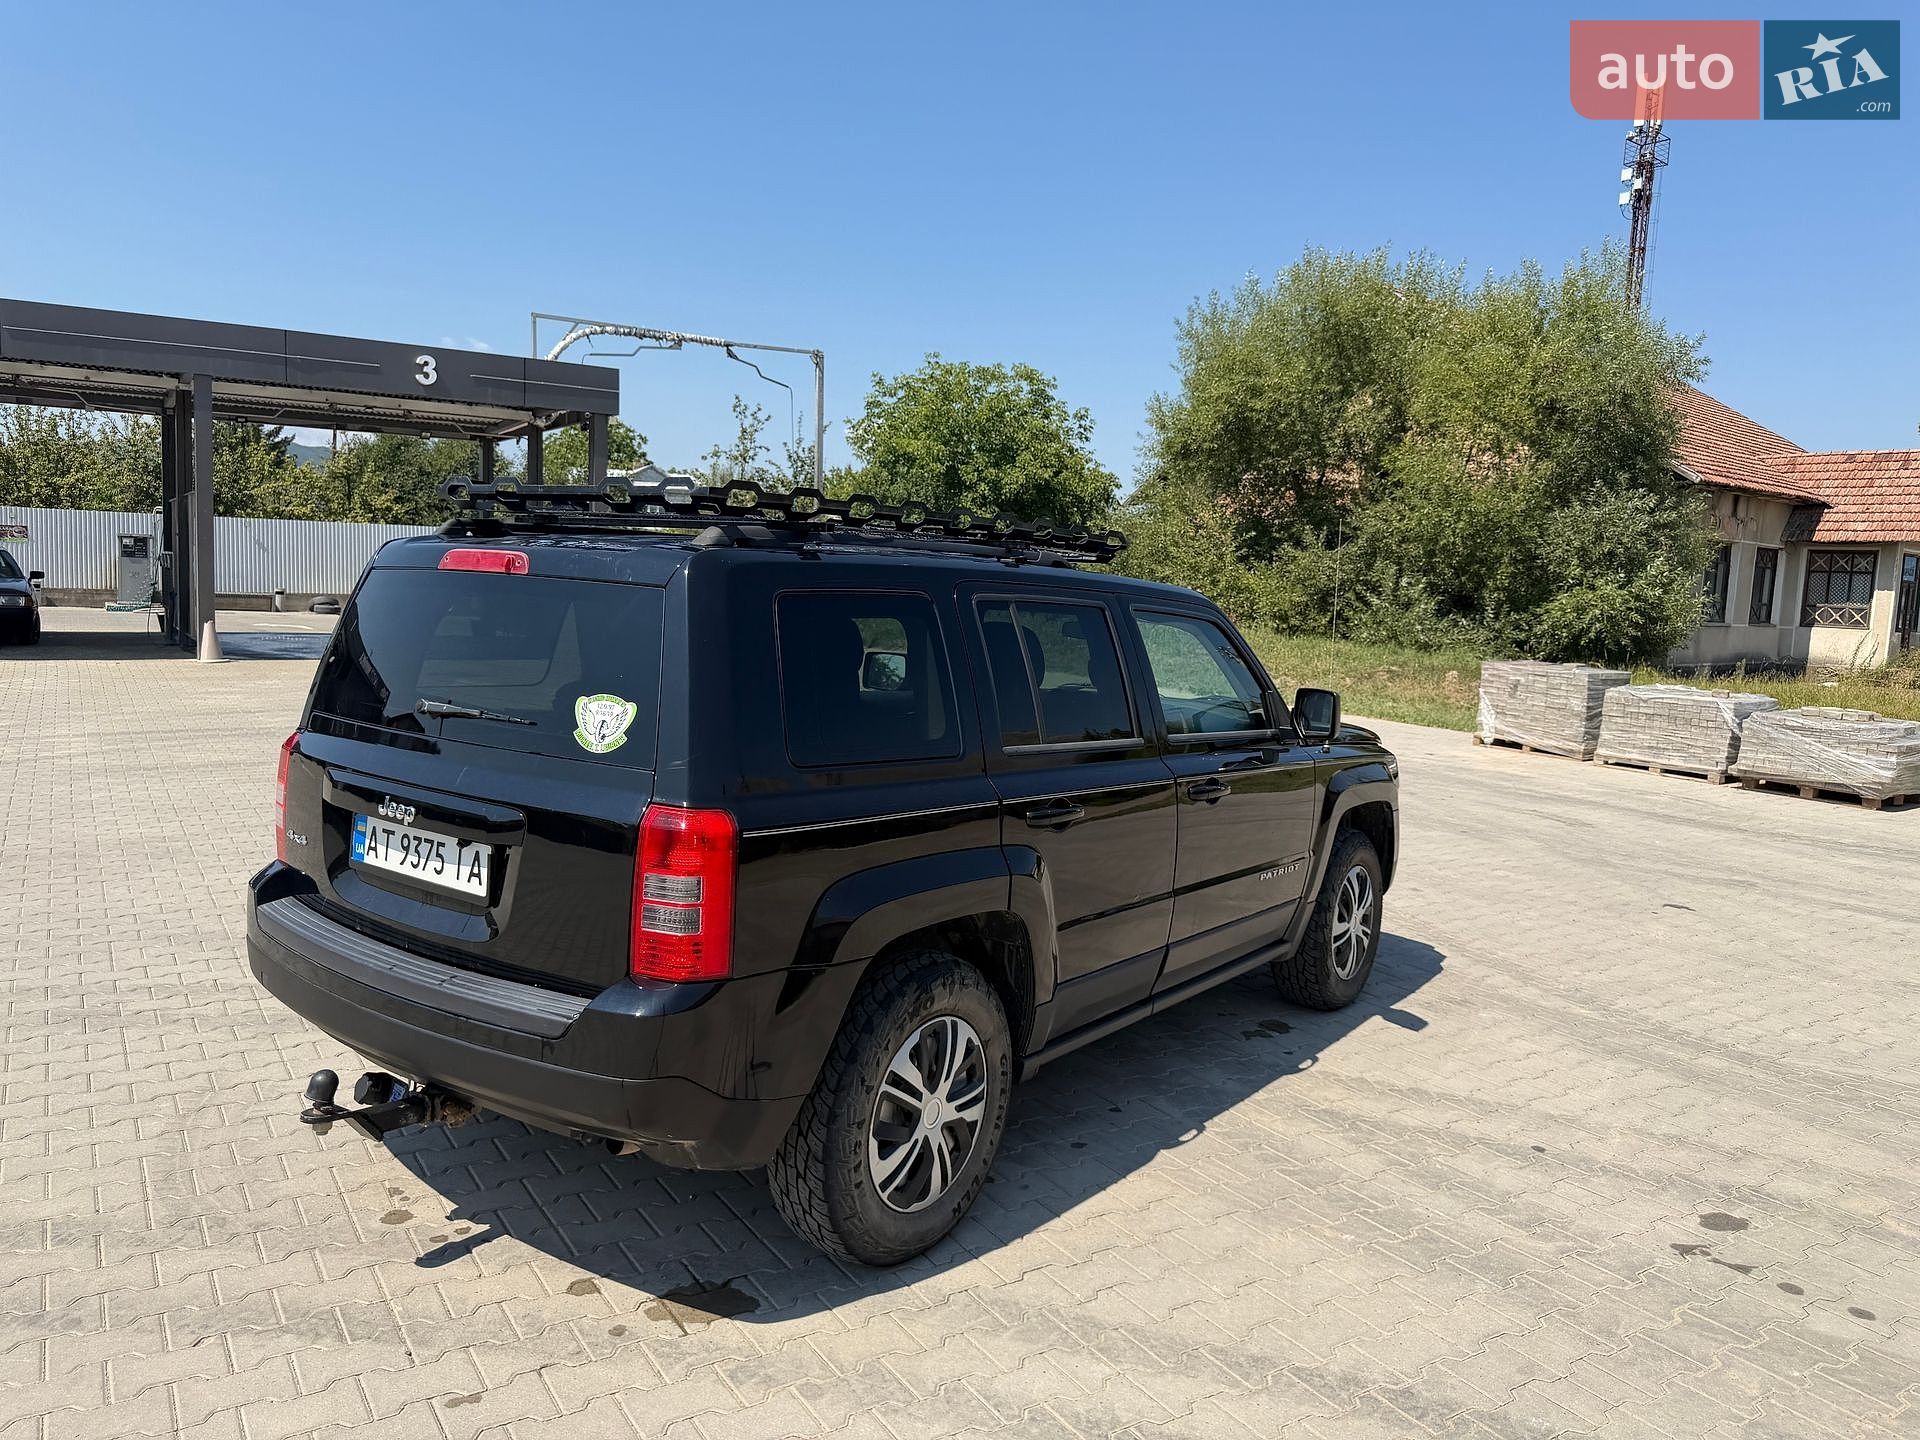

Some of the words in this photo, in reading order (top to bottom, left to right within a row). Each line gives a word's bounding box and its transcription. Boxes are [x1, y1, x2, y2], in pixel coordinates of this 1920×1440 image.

[415, 354, 438, 386] 3
[378, 795, 416, 826] Jeep
[355, 842, 365, 855] UA
[366, 825, 396, 862] AT
[399, 833, 446, 875] 9375
[1260, 863, 1300, 881] PATRIOT
